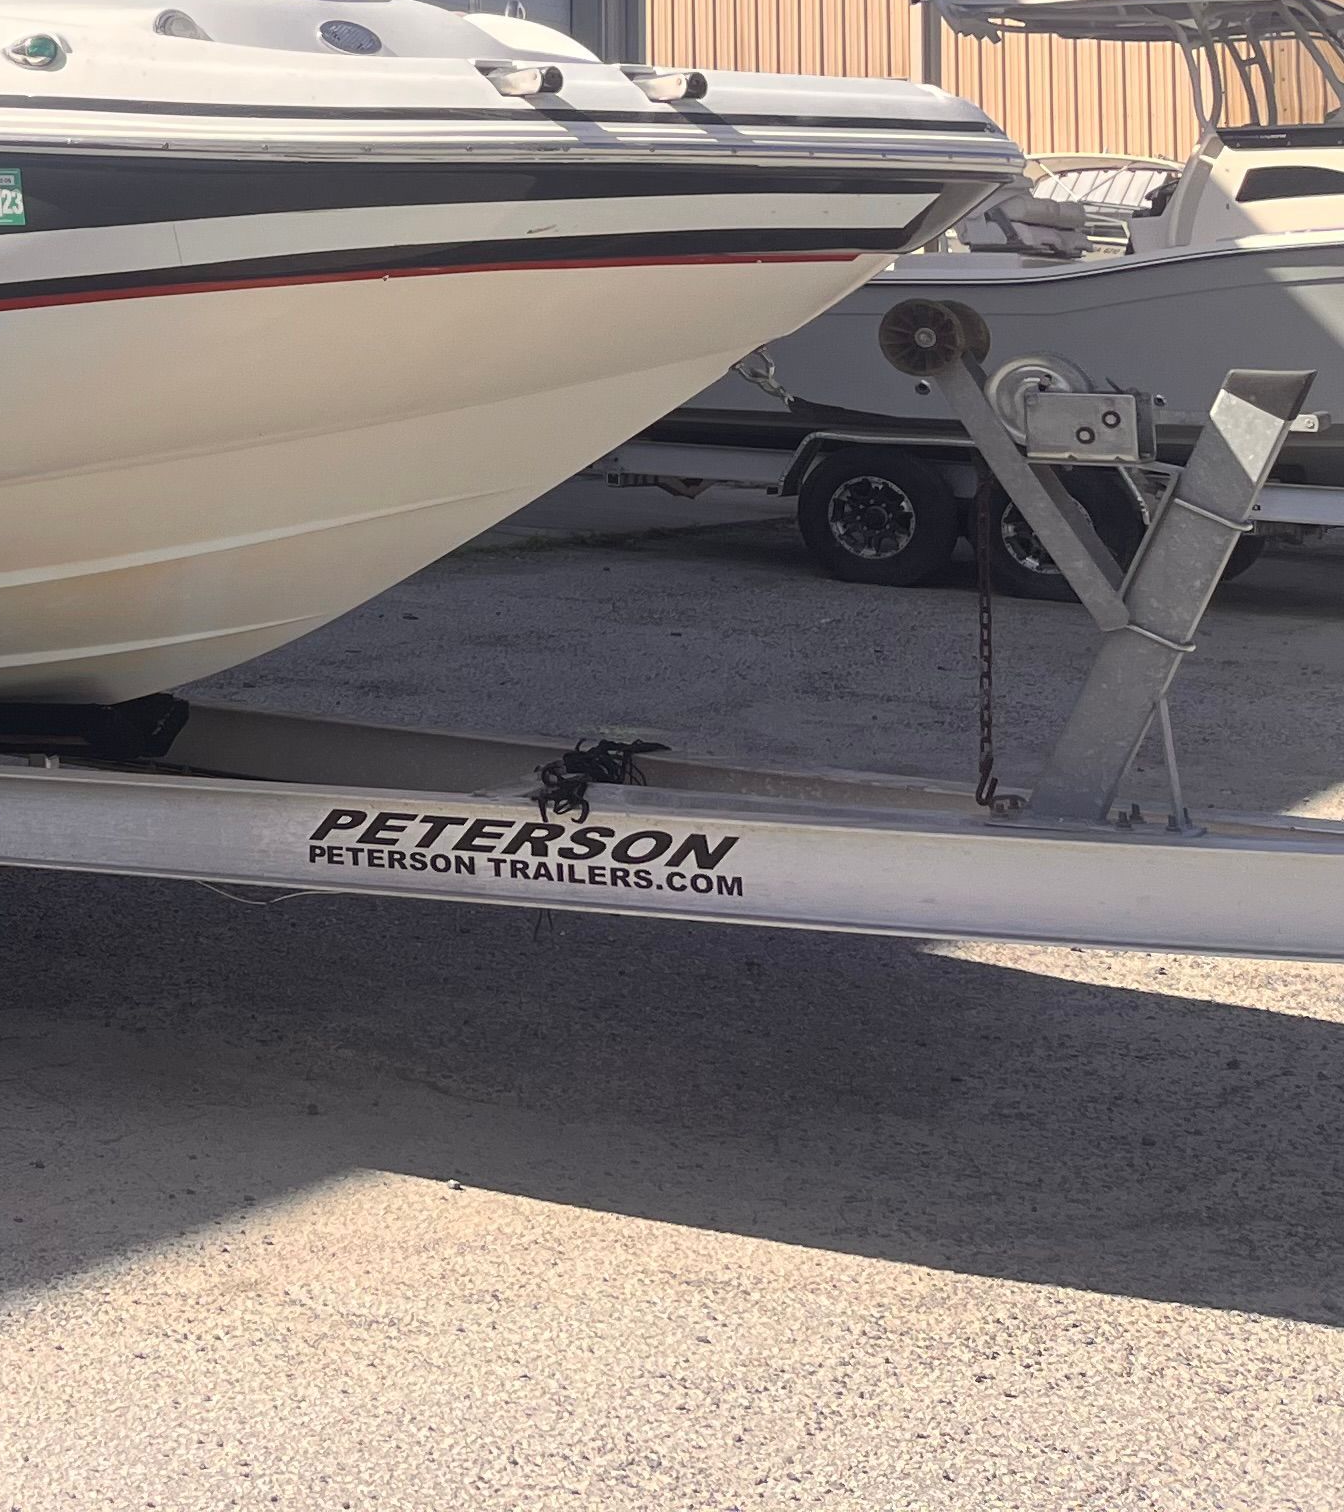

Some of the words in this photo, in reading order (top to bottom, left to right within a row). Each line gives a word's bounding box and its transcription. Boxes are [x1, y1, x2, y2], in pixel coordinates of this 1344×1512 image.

[308, 807, 740, 870] PETERSON
[309, 845, 476, 876] PETERSON
[487, 857, 744, 897] TRAILERS.COM
